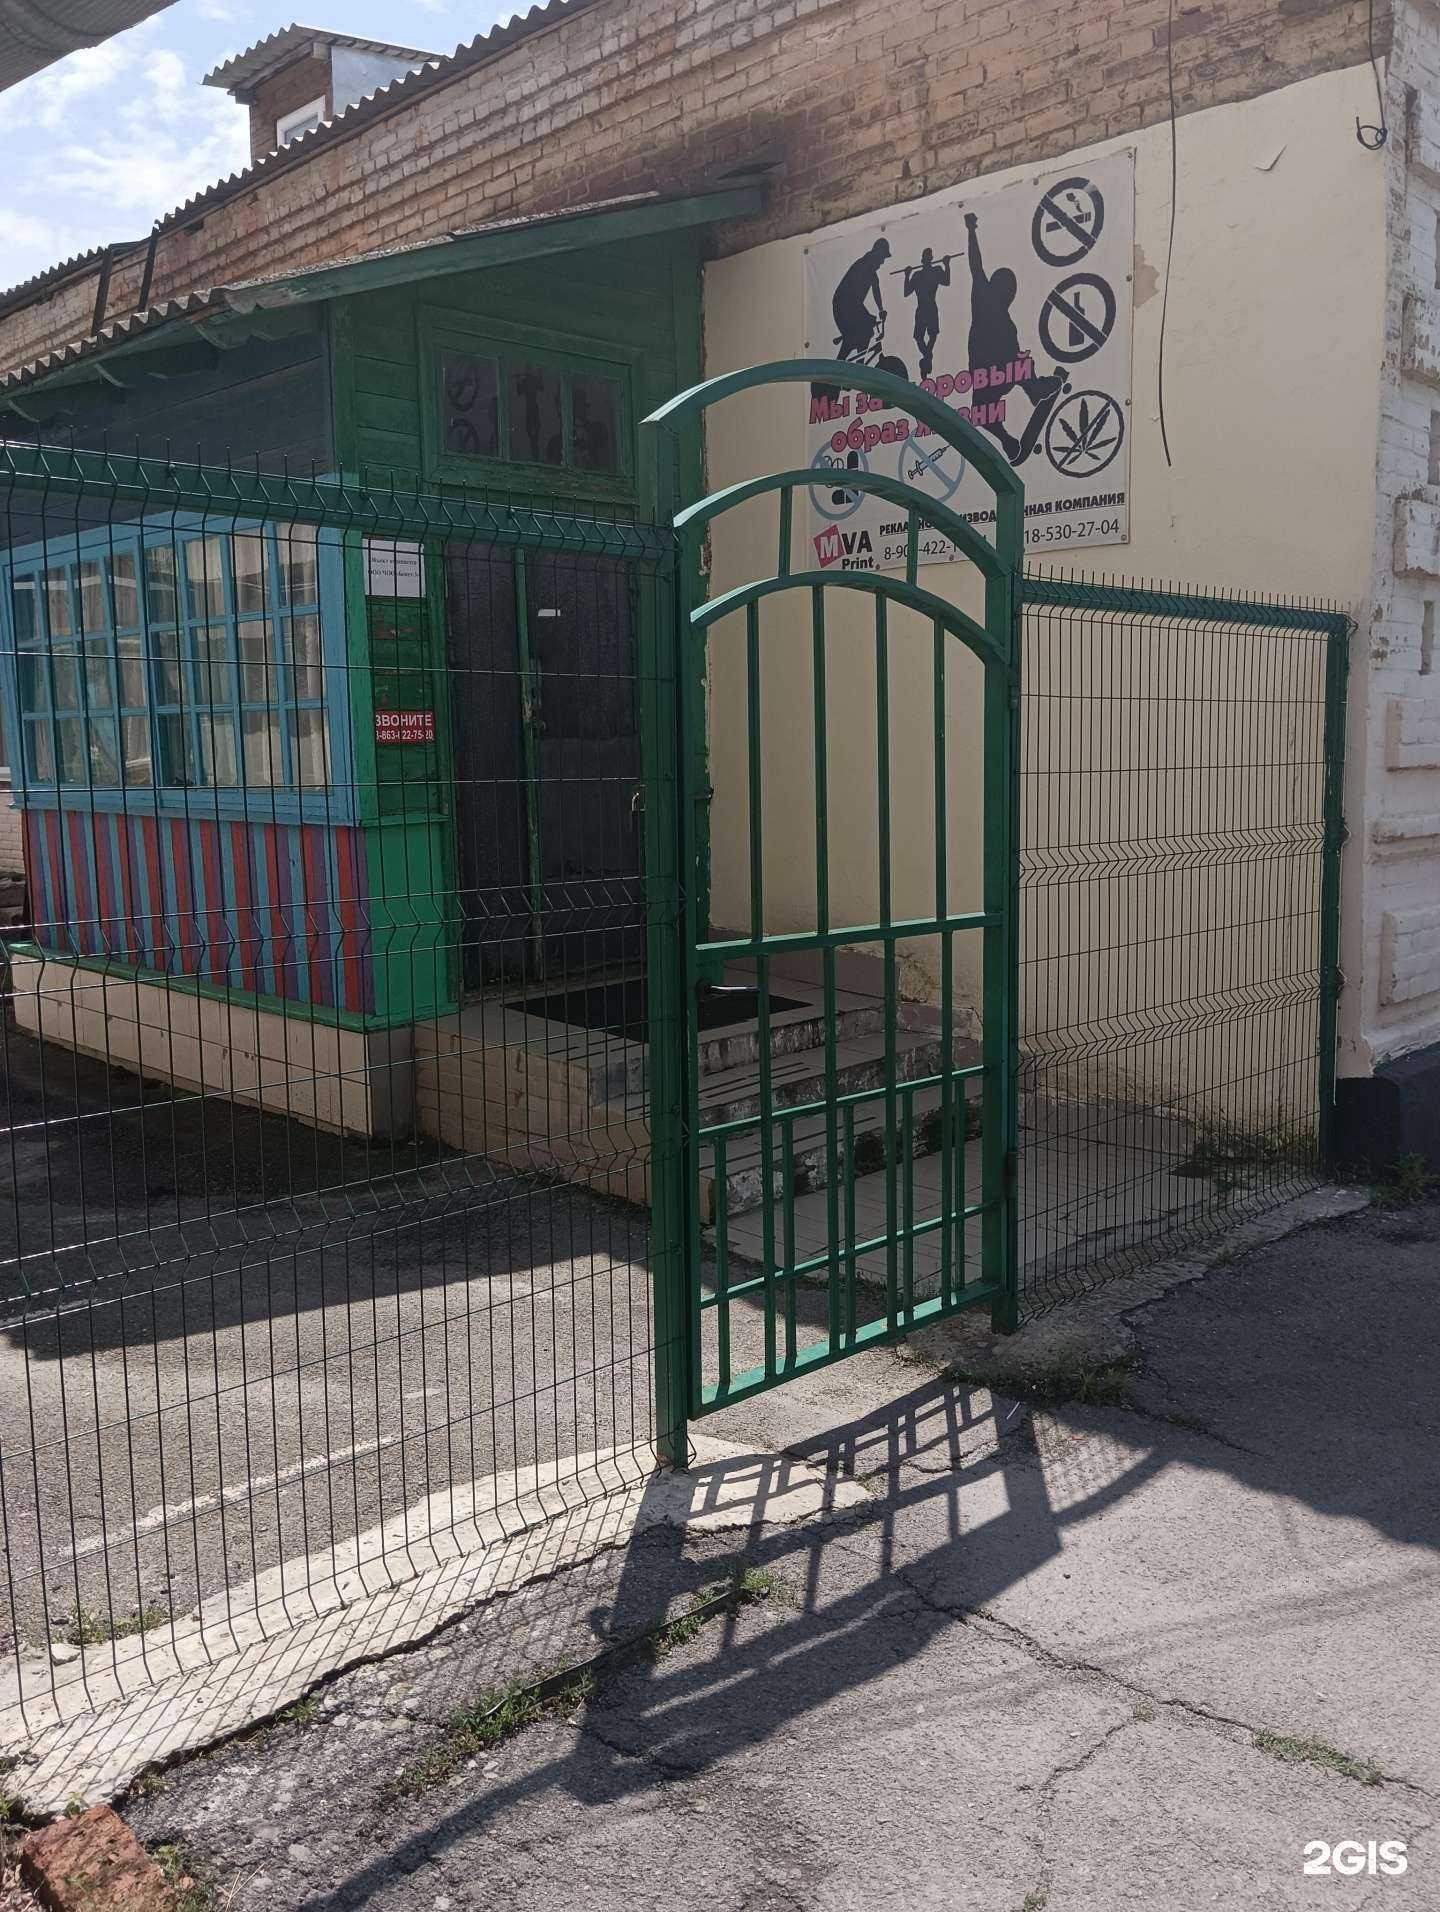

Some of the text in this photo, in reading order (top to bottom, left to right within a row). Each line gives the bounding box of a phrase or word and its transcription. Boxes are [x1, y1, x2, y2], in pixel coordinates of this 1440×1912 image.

[809, 396, 850, 424] Мы
[918, 349, 1034, 401] оровый
[830, 416, 910, 453] образ
[1055, 492, 1125, 512] КОМПАНИЯ
[820, 530, 873, 559] MVA
[842, 556, 874, 571] Print
[376, 714, 433, 727] ЗВОНИТЕ
